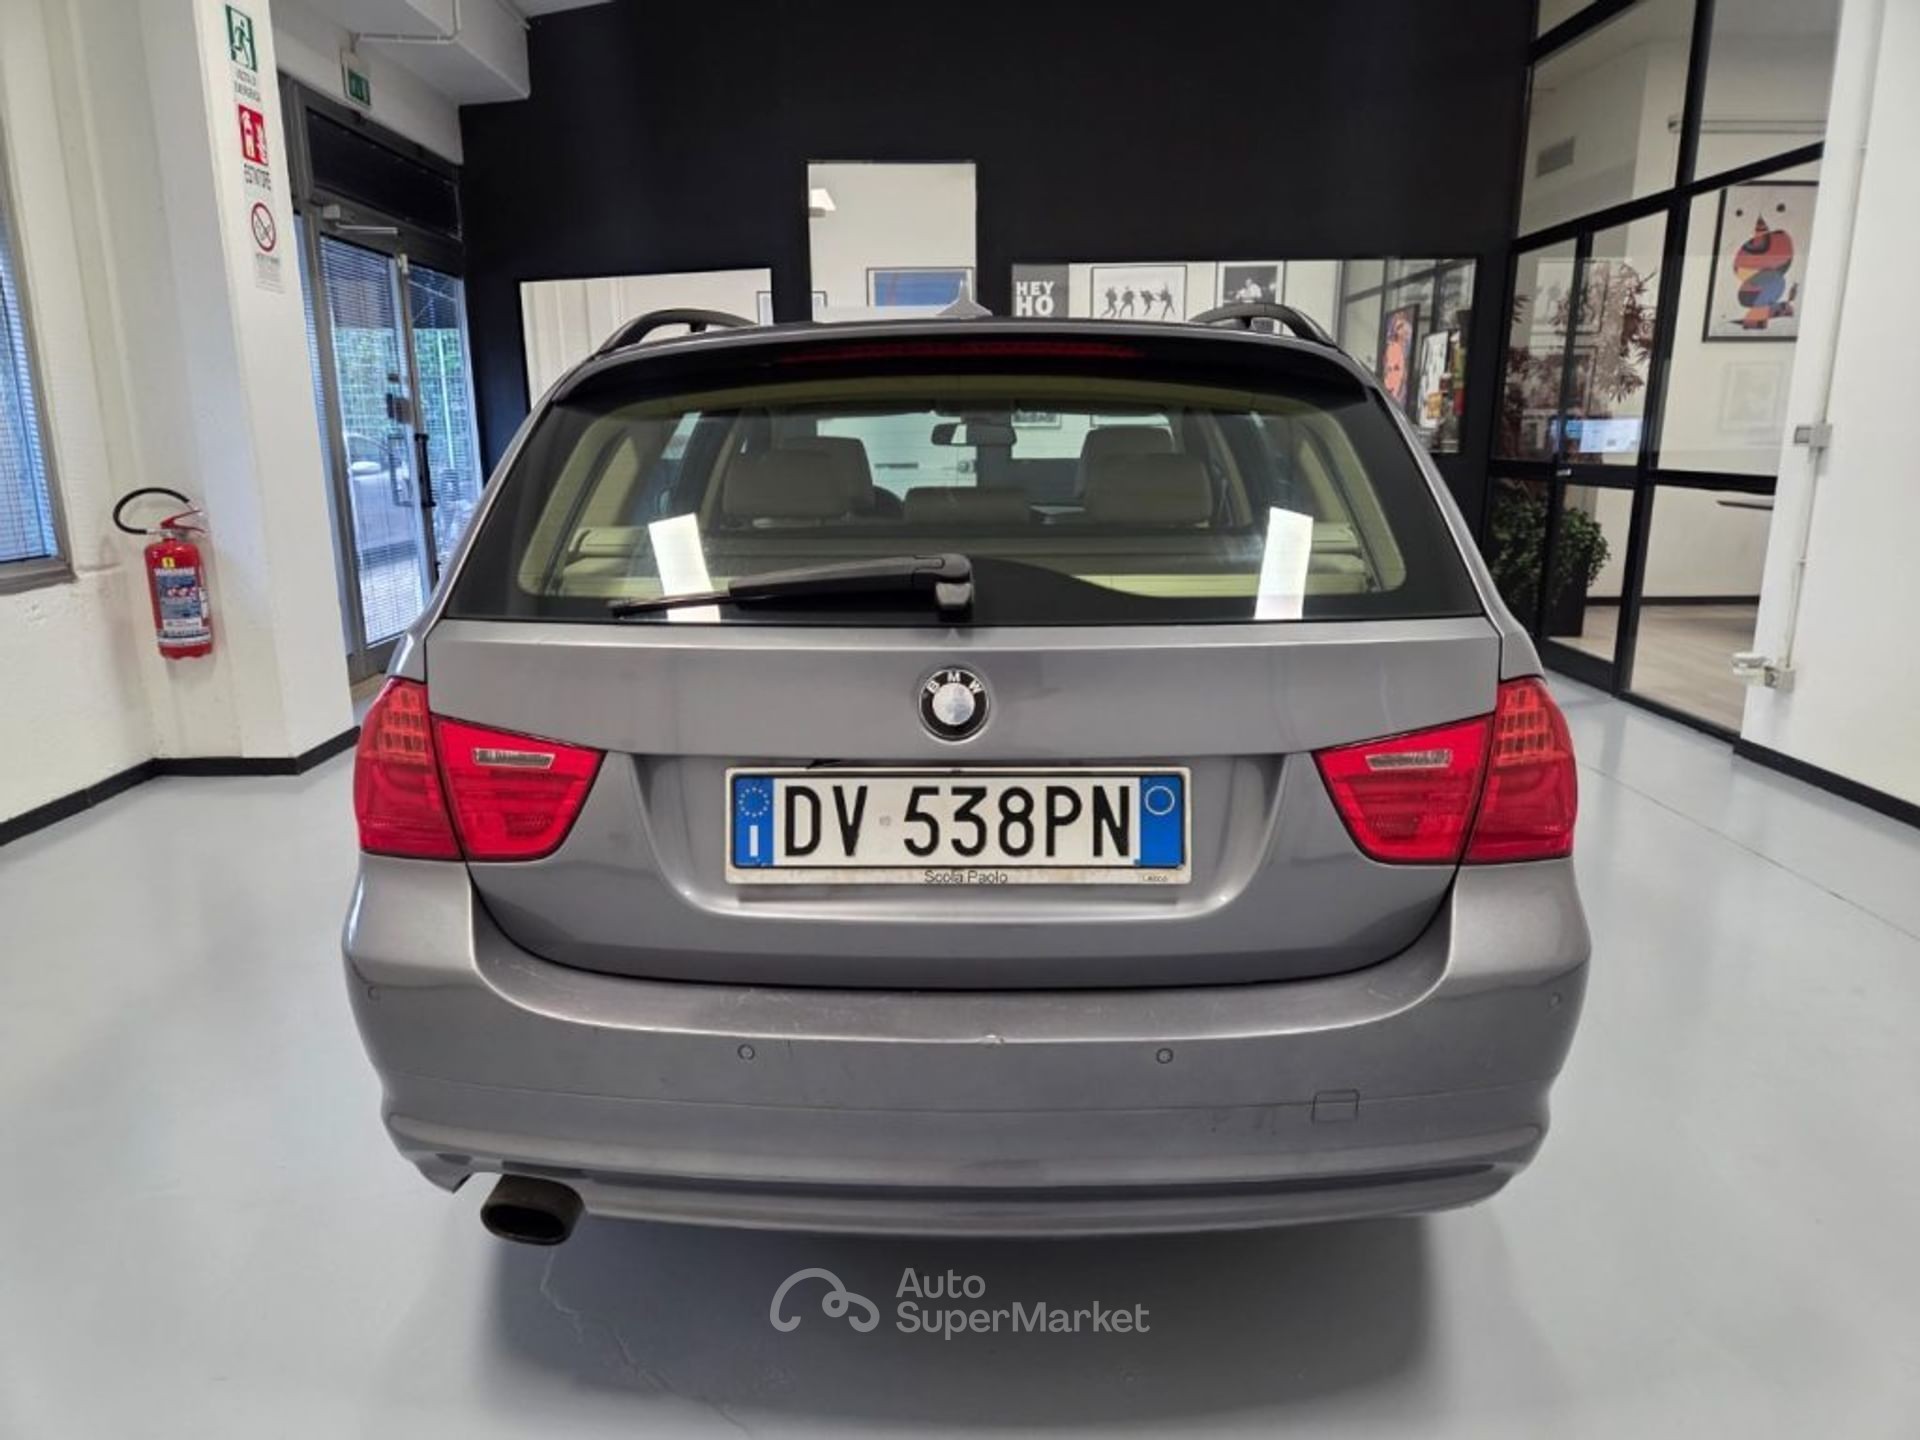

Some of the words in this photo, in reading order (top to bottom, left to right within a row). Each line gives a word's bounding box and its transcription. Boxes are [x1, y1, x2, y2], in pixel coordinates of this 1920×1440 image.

[1016, 281, 1055, 296] HEY
[1016, 295, 1054, 317] HO
[926, 671, 985, 694] BMW
[784, 785, 868, 857] DV
[904, 785, 1130, 857] 538PN
[749, 825, 759, 857] I
[967, 869, 1008, 883] Paolo
